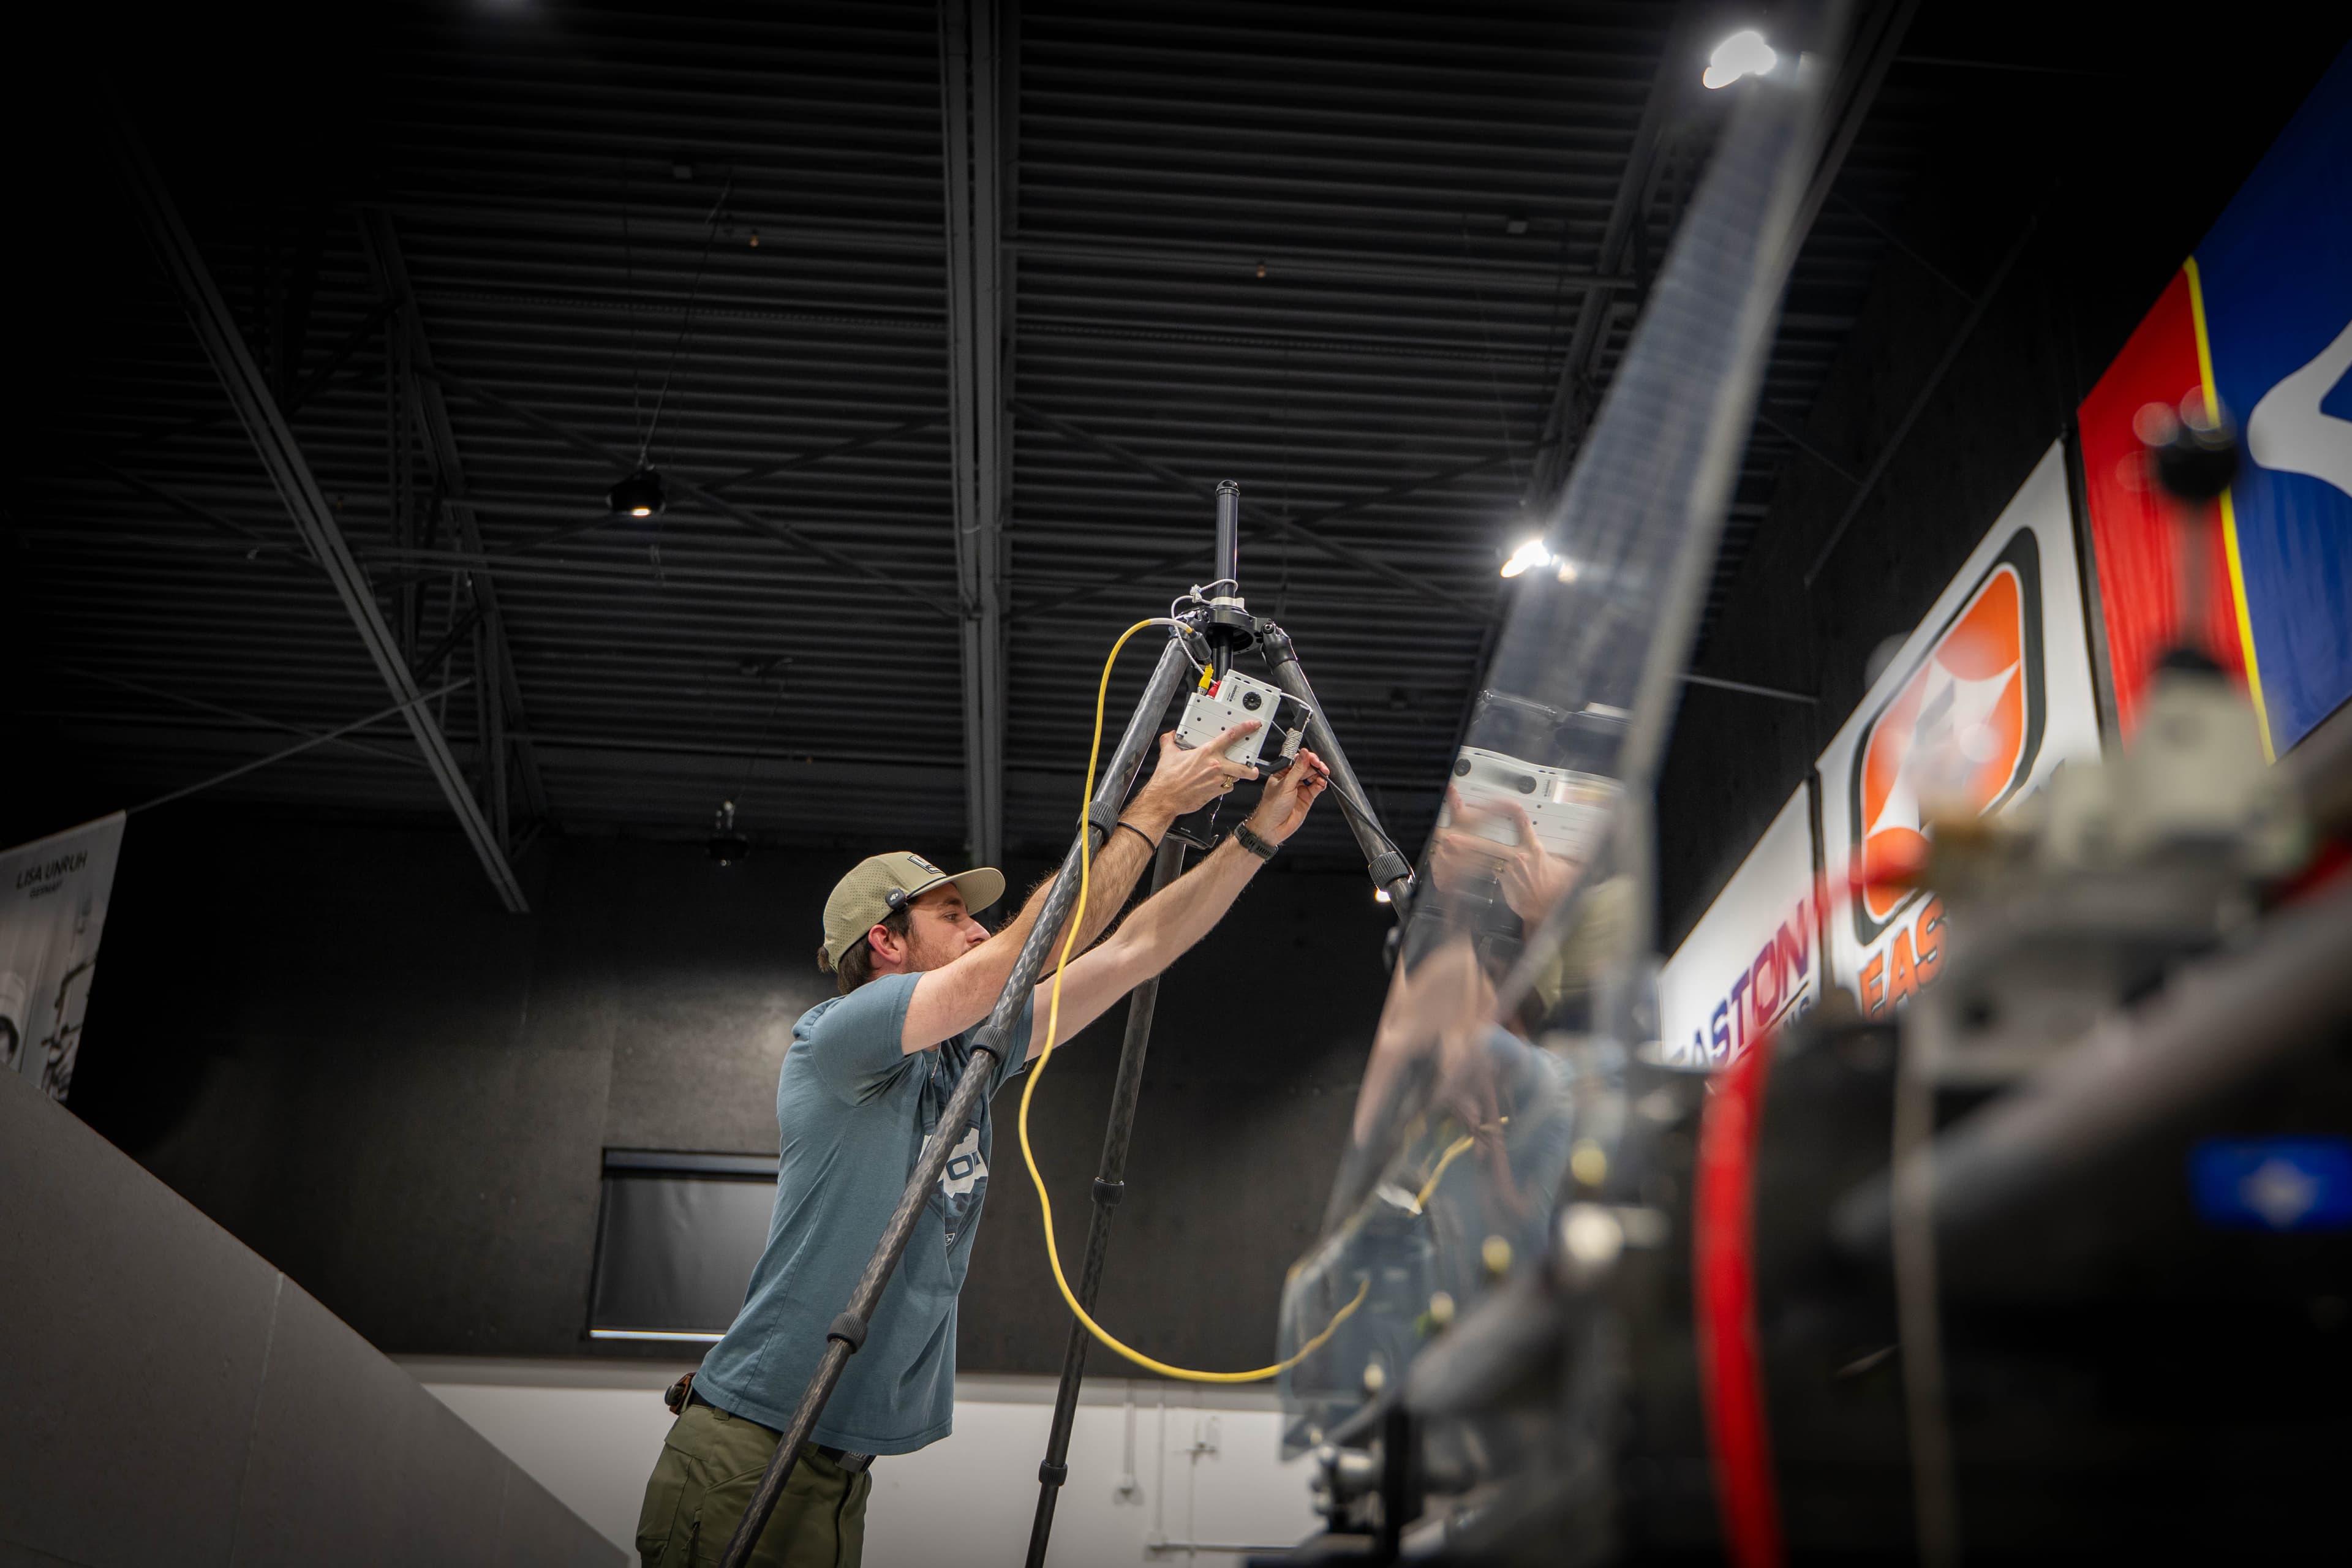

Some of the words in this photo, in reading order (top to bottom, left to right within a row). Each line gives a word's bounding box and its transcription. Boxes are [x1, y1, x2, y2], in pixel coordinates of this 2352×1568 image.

[17, 864, 42, 889] LISA
[45, 850, 88, 879] UNRUH
[1670, 899, 1809, 1067] ASTON
[1859, 897, 1947, 1020] EAS
